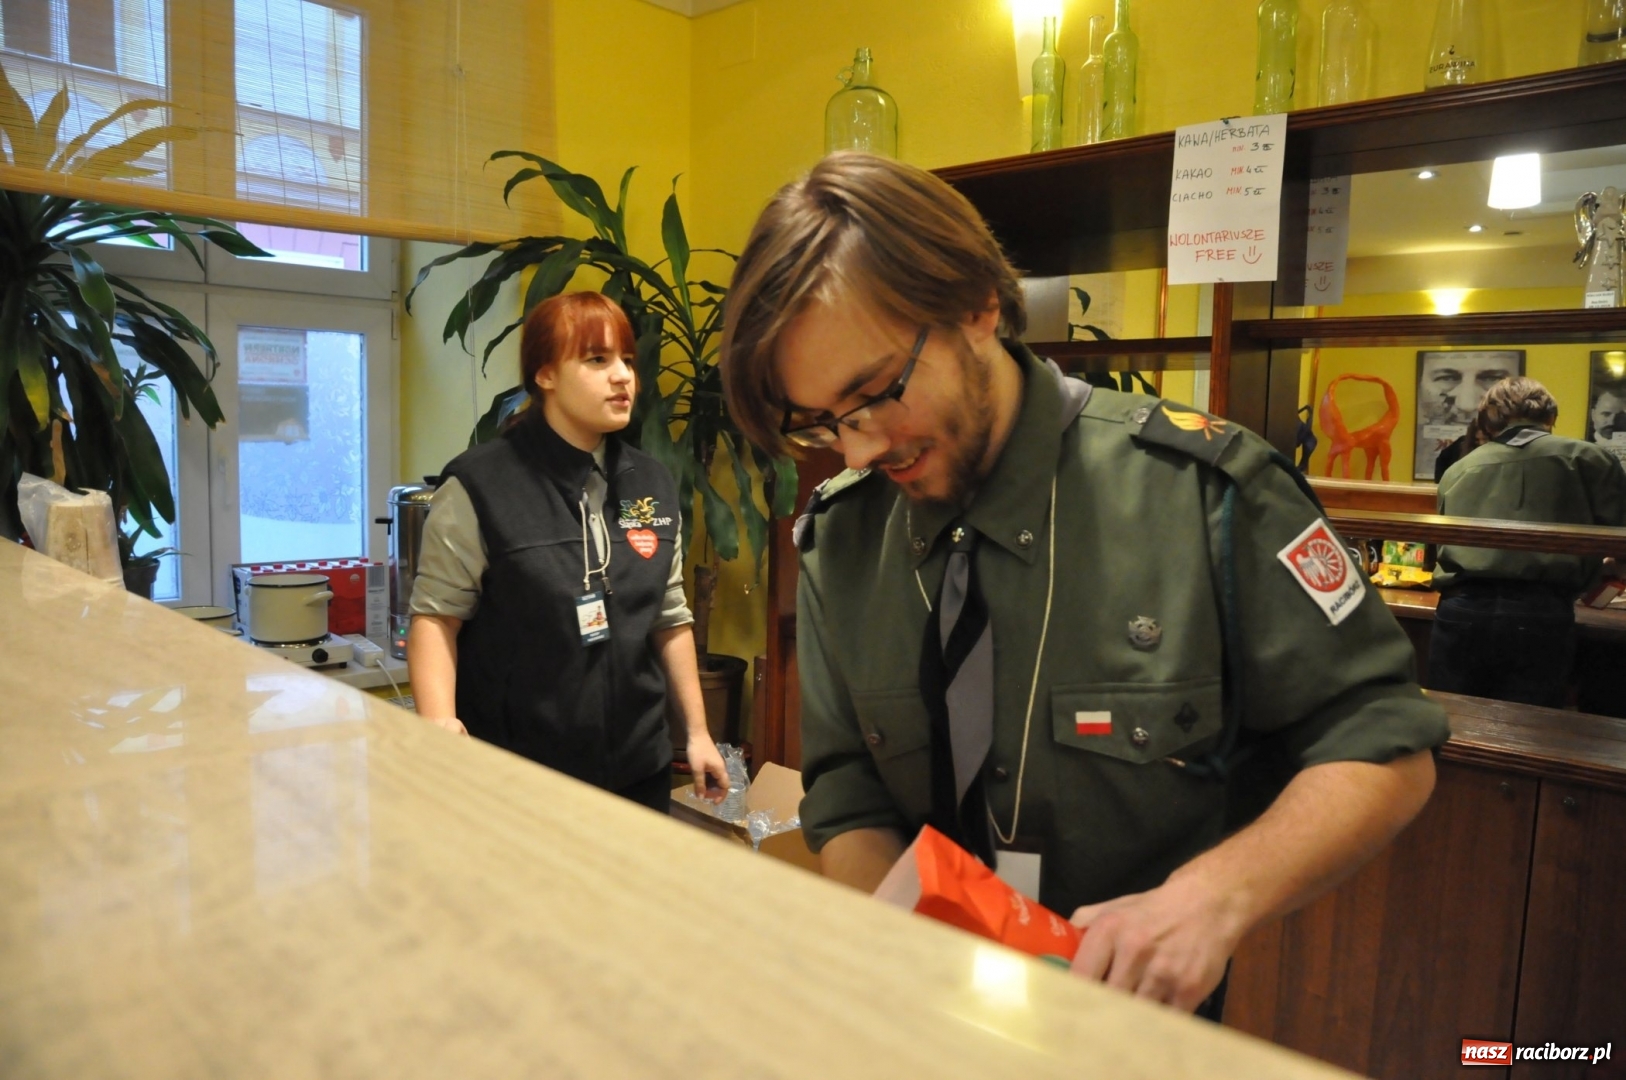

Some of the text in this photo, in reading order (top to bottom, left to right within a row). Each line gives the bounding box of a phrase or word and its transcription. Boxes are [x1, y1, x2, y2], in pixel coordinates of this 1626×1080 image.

[1175, 167, 1213, 181] KAKAO
[1172, 190, 1213, 202] CIACHO
[1170, 229, 1266, 247] WOLONTARIUSZE
[1195, 249, 1237, 262] FREE
[653, 517, 672, 526] ZHP
